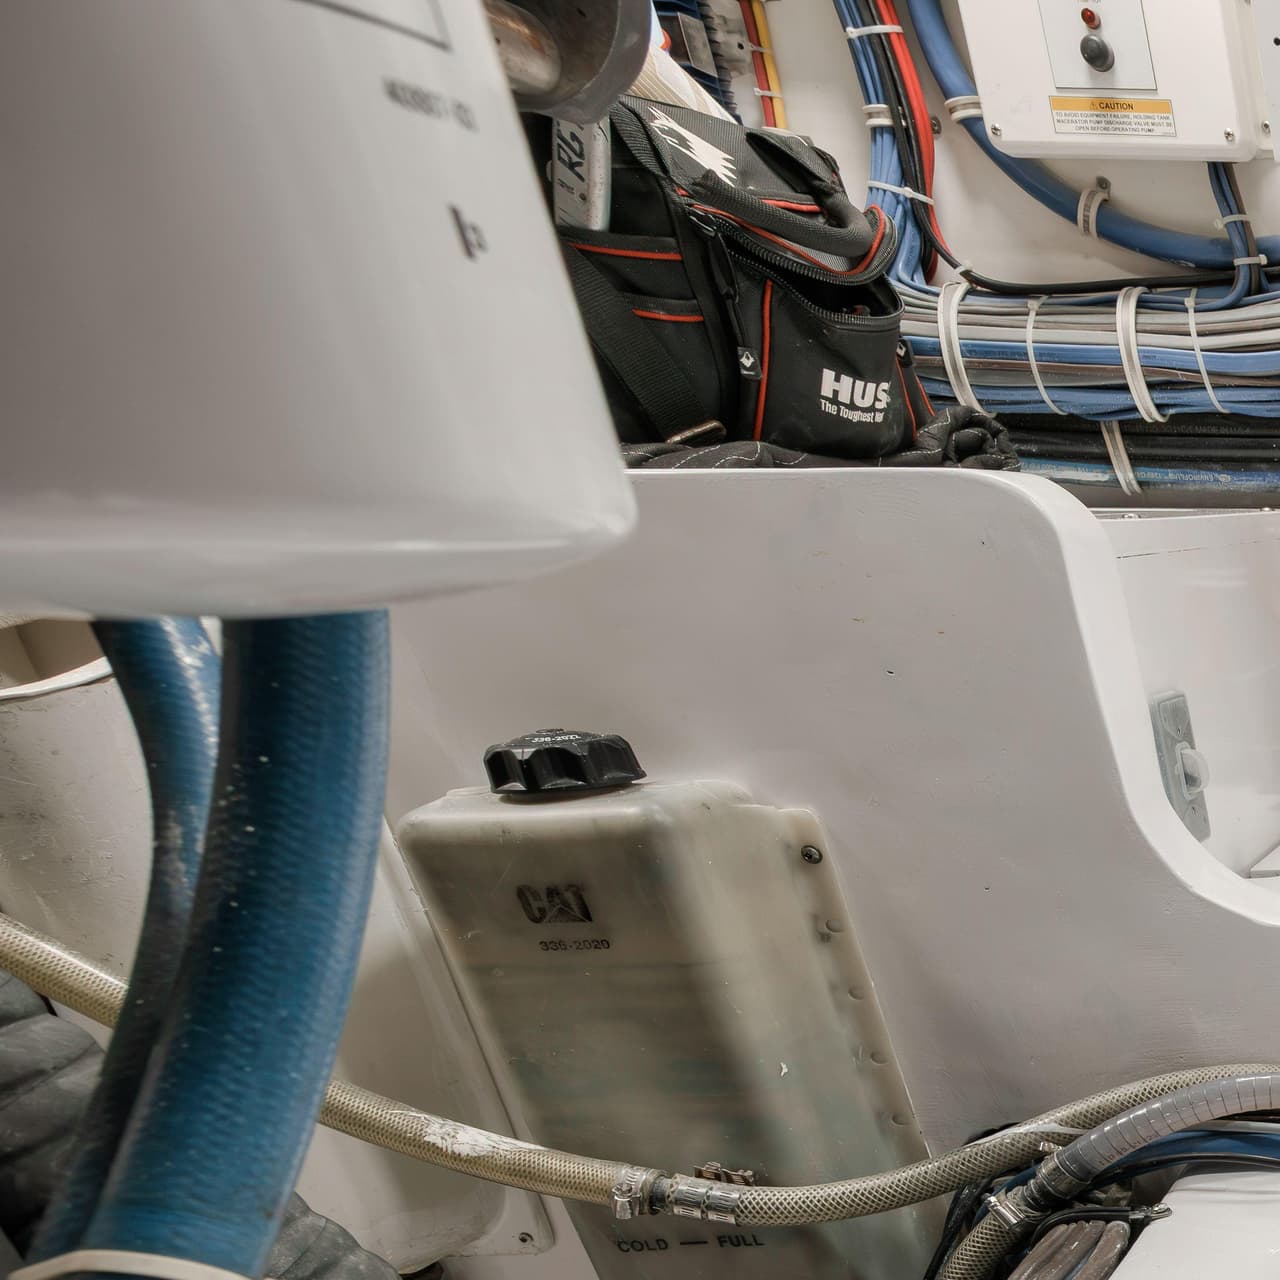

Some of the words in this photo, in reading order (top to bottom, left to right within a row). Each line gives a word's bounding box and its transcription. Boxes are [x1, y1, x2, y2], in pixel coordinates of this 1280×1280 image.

[1098, 101, 1134, 110] CAUTION
[820, 398, 838, 415] The
[840, 405, 874, 423] Toughest
[516, 884, 592, 924] CAT
[616, 1238, 669, 1253] COLD
[717, 1234, 766, 1248] FULL
